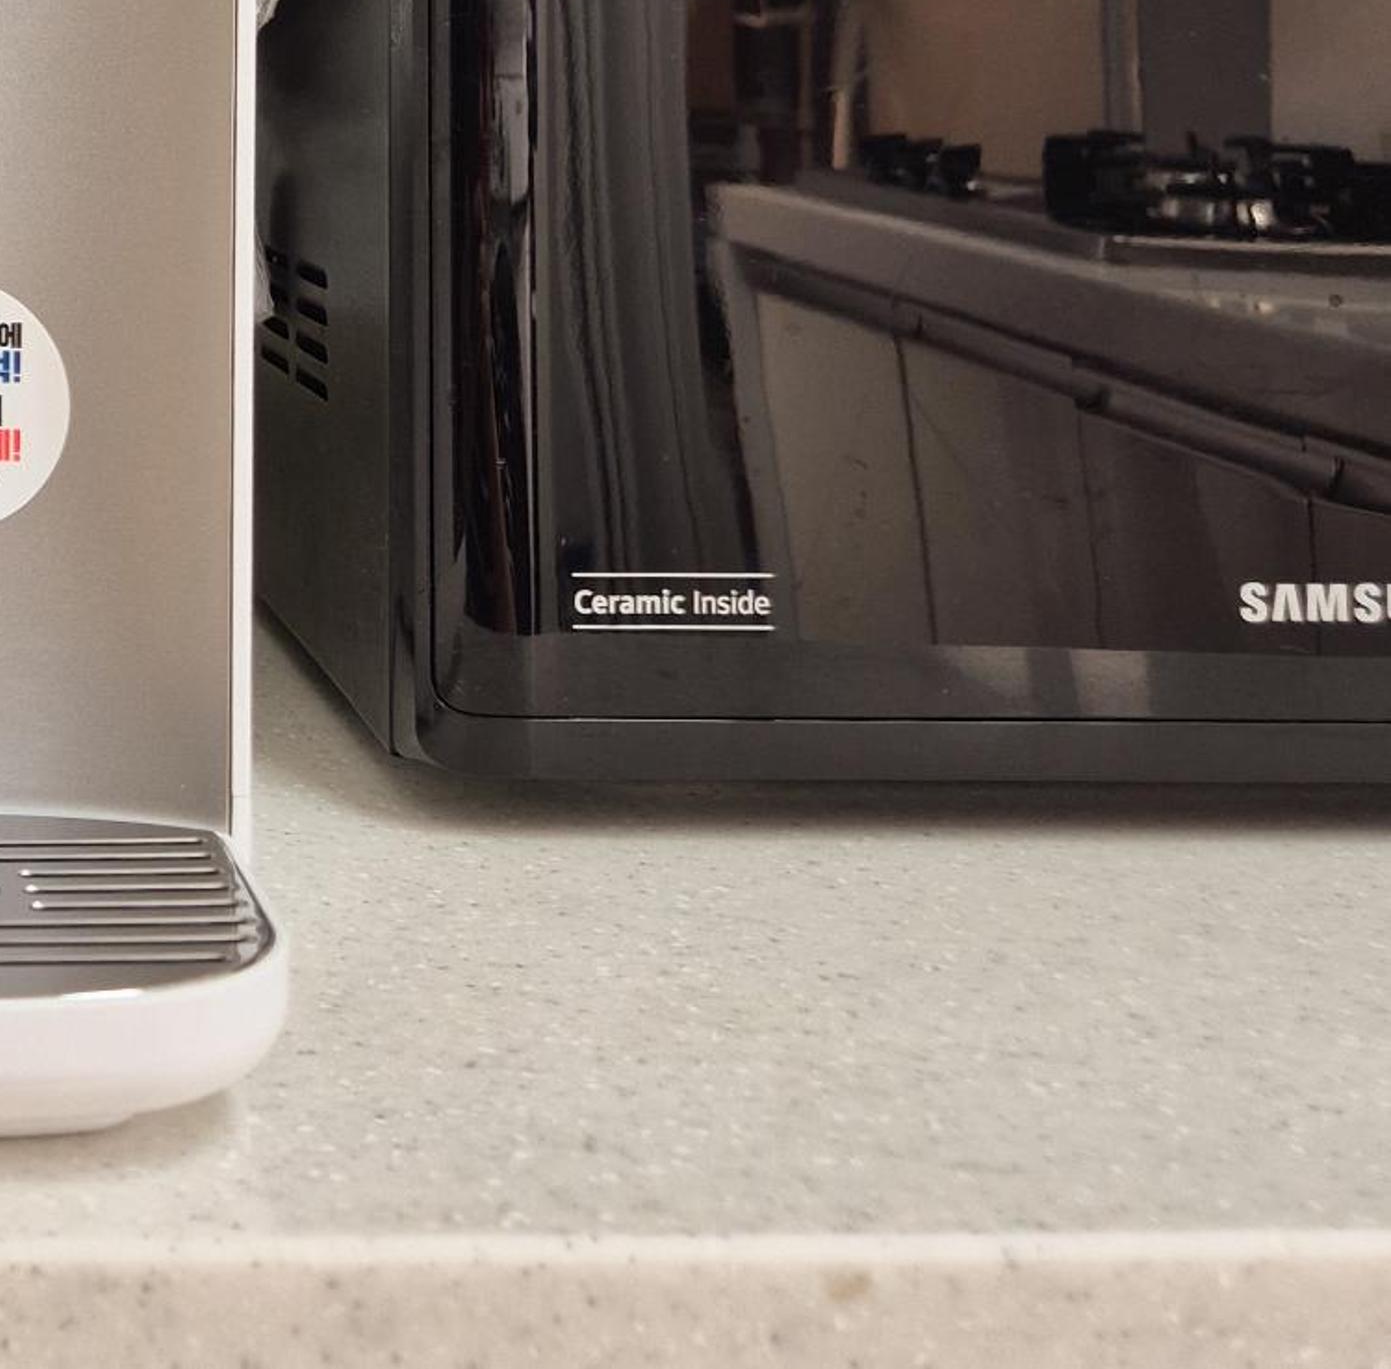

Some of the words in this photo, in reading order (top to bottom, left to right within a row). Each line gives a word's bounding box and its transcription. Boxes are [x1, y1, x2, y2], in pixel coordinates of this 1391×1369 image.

[574, 588, 686, 615] Ceramic
[693, 589, 771, 615] Inside
[1239, 582, 1391, 623] SAMS
